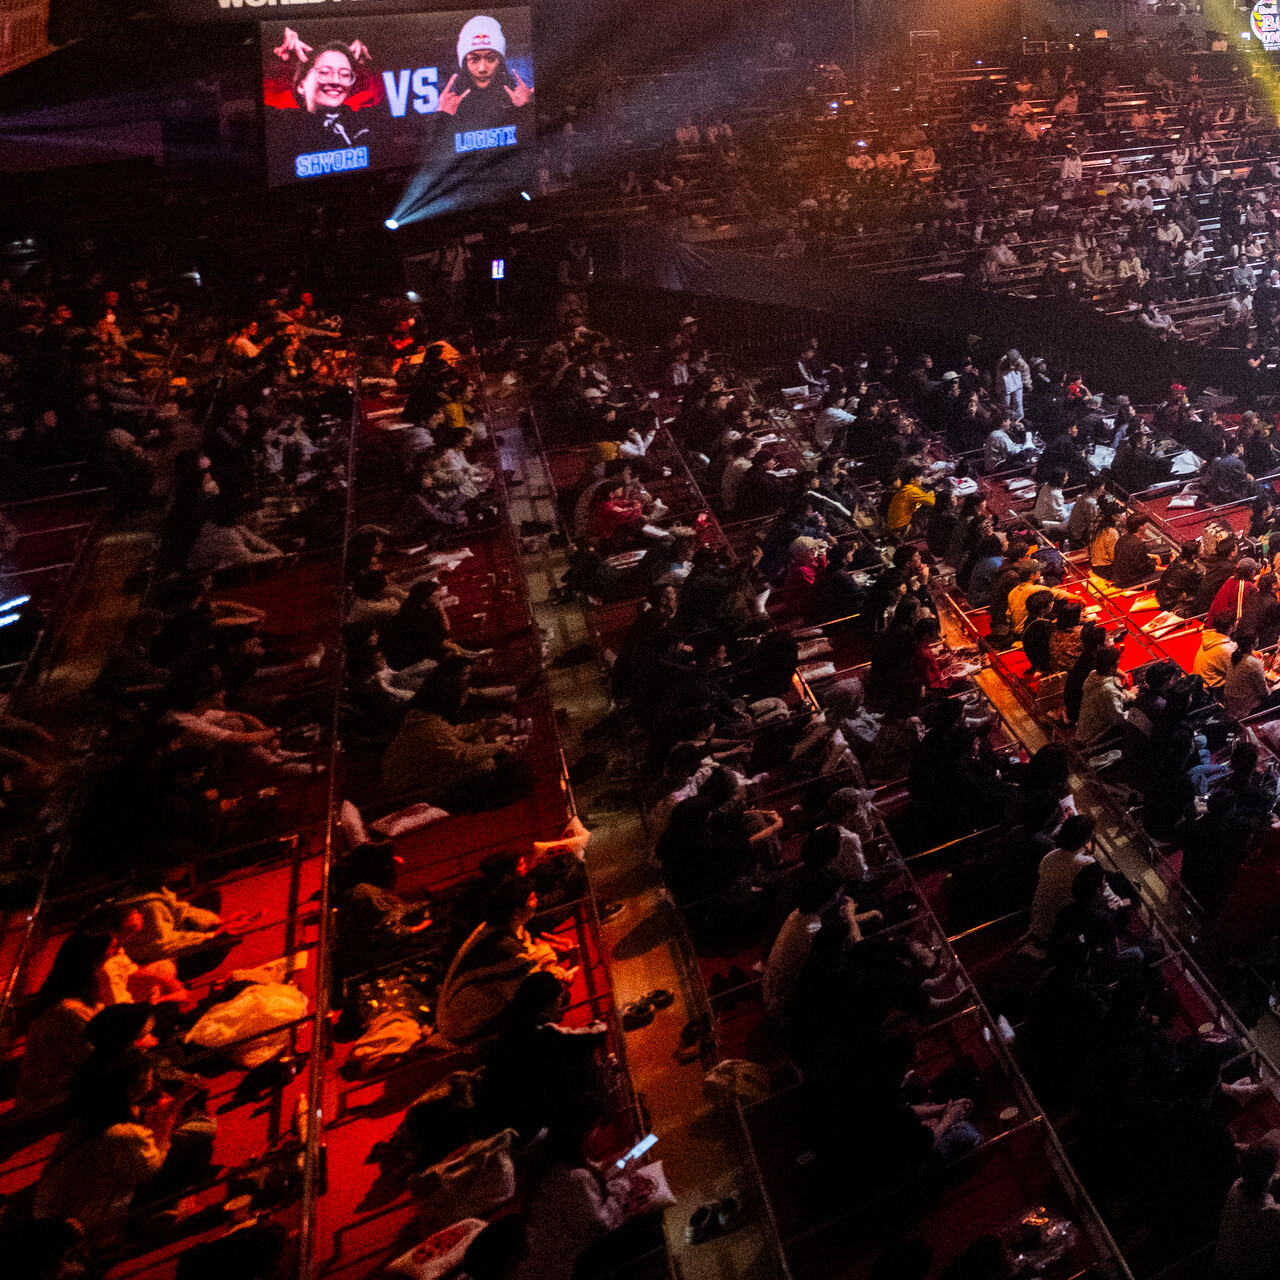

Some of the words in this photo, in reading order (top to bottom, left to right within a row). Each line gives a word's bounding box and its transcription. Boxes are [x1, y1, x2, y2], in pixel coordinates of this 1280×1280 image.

[383, 67, 439, 118] VS
[455, 126, 517, 152] LOGISTX
[296, 146, 368, 177] SAYORA
